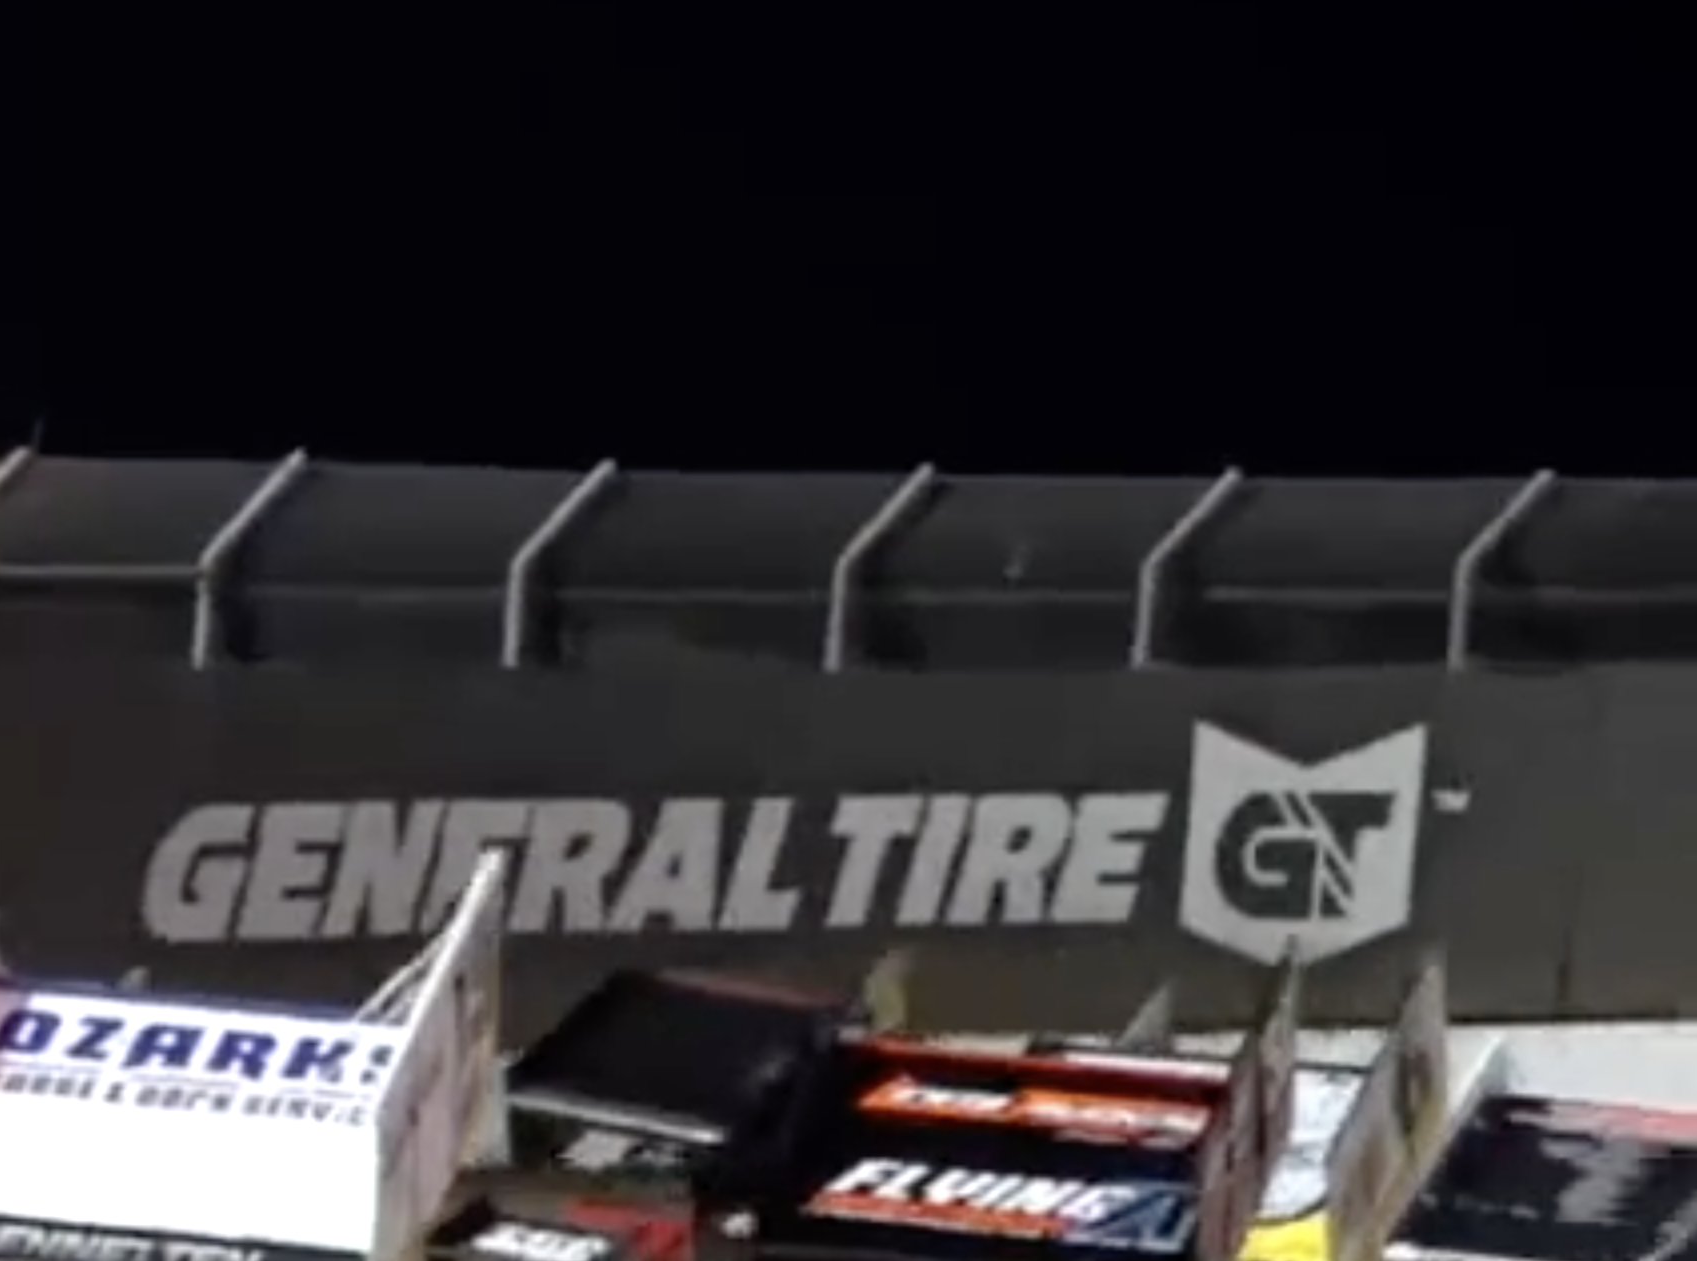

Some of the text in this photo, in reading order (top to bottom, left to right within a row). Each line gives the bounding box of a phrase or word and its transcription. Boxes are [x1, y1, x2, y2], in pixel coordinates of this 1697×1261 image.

[140, 791, 1170, 944] GENERAL TIRE
[822, 1156, 1140, 1222] FLYING
